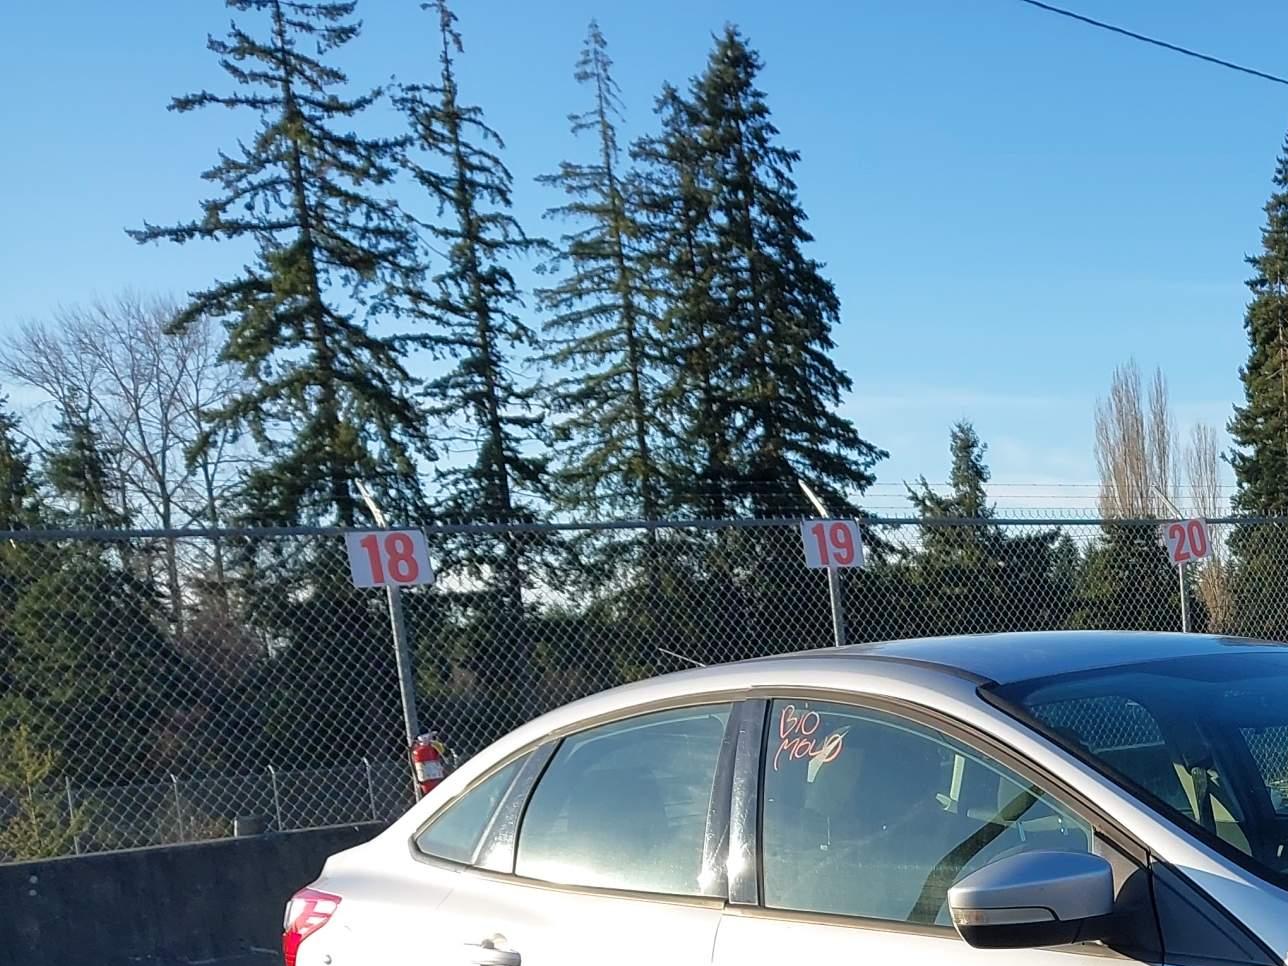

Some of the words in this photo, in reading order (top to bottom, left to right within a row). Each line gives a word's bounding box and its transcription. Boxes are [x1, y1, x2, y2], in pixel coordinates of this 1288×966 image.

[360, 532, 419, 584] 18
[811, 522, 855, 566] 19
[1169, 520, 1207, 561] 20
